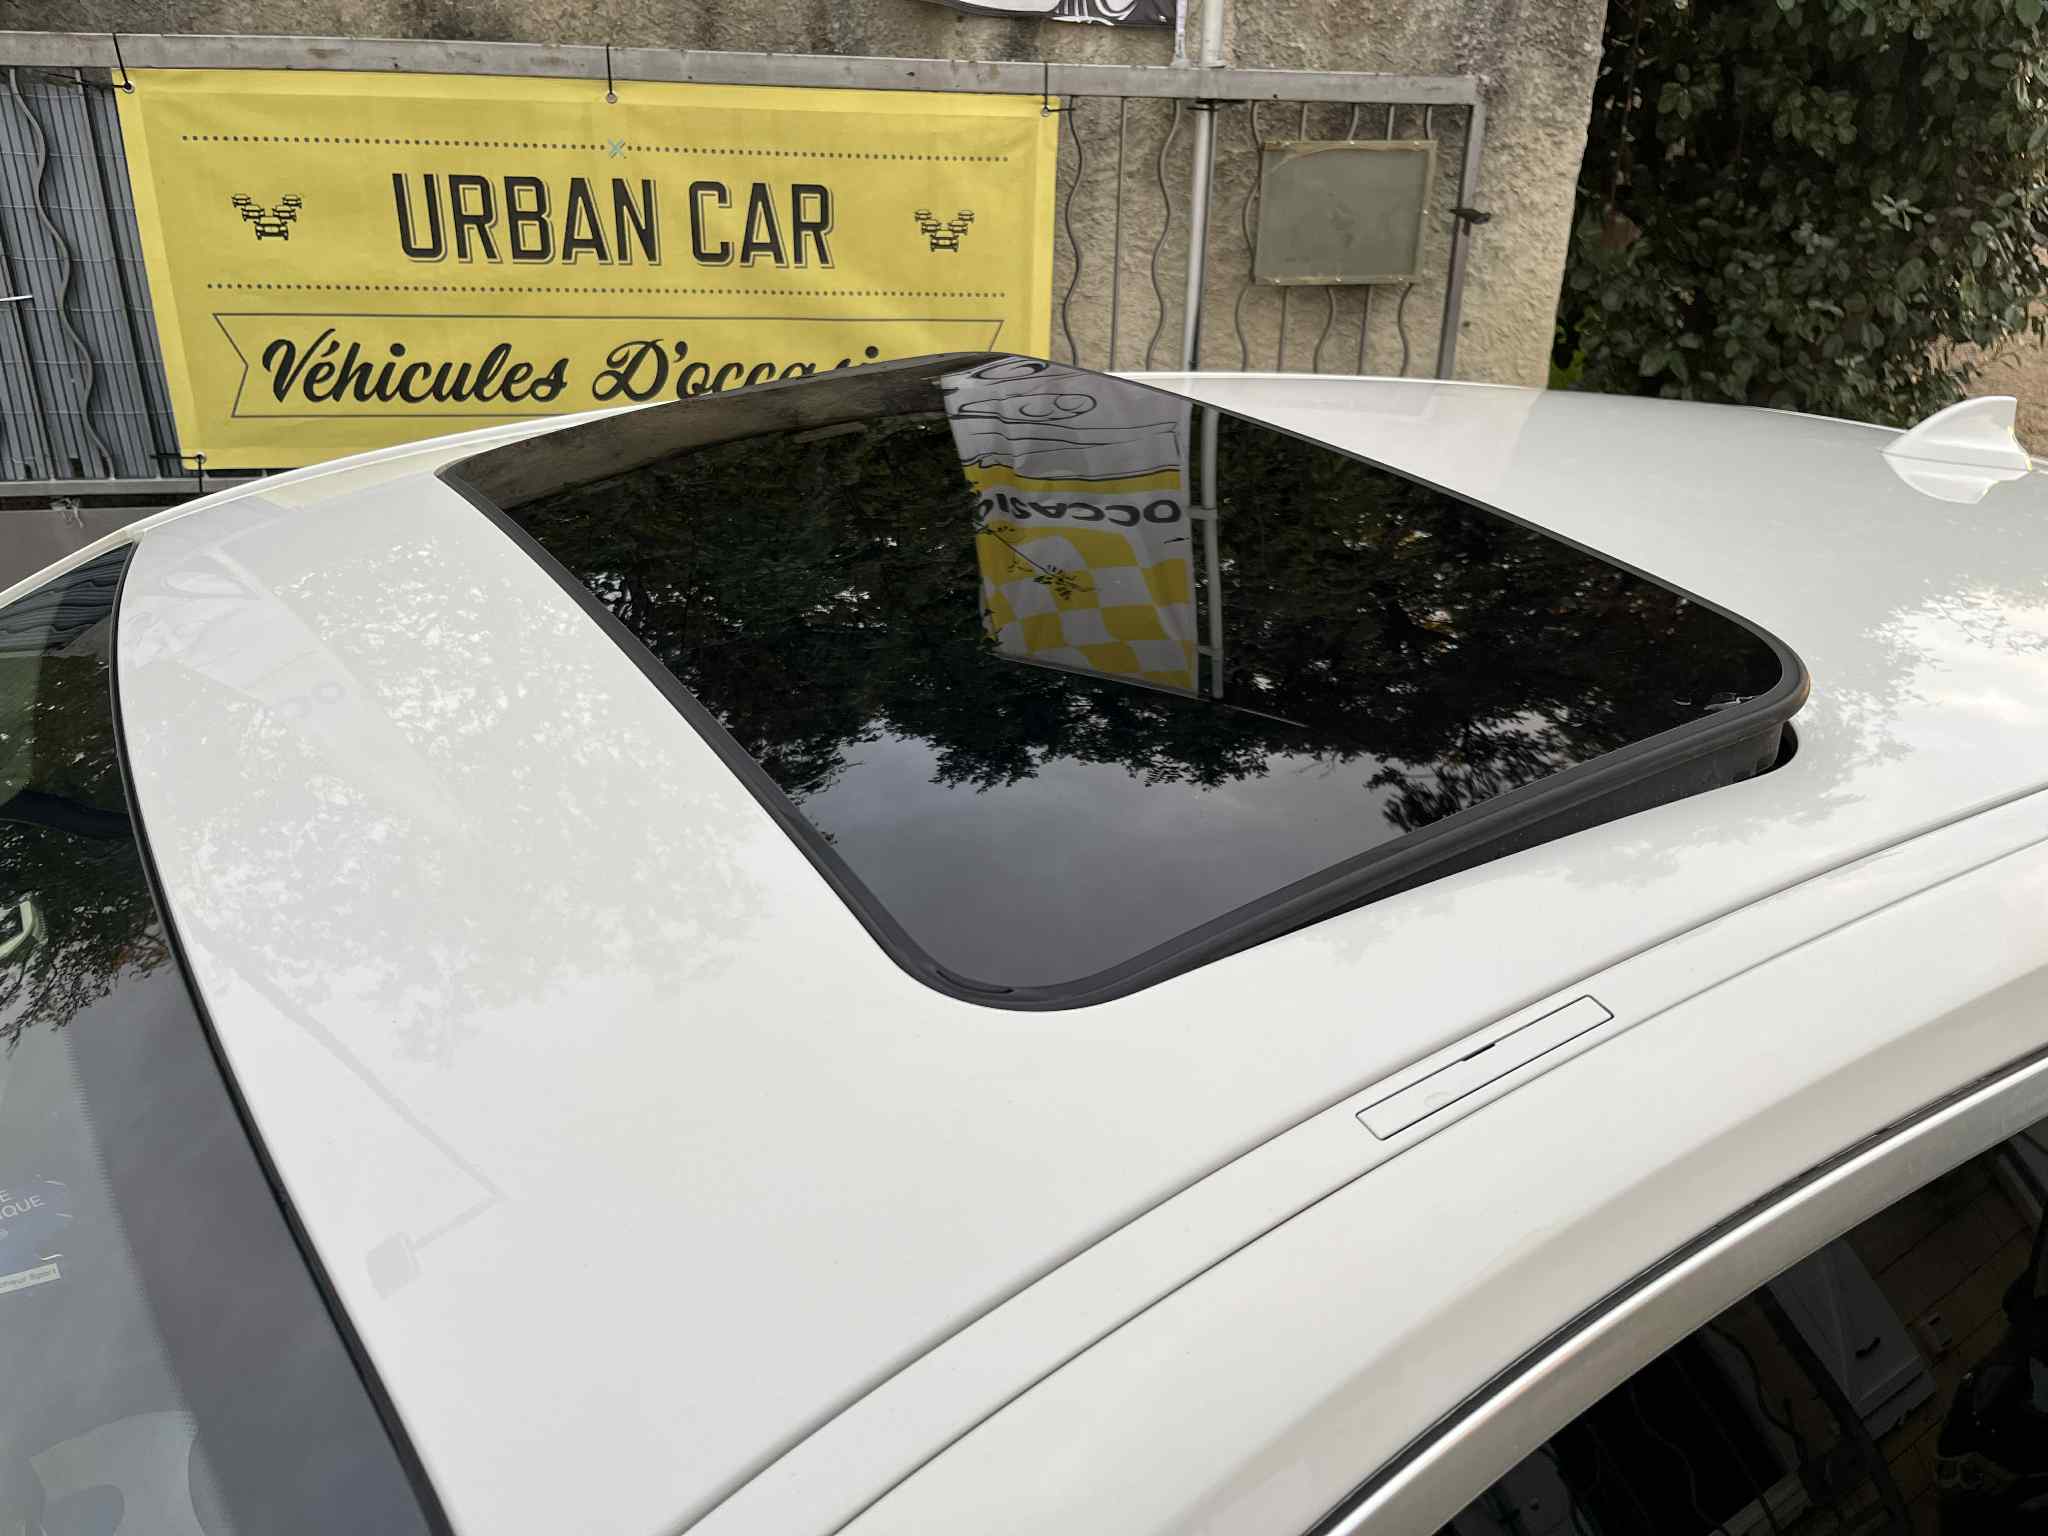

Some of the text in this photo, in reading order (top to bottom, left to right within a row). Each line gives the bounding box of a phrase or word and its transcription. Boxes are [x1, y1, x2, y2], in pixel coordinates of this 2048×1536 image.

[392, 173, 834, 269] URBAN CAR
[262, 328, 569, 402] Véhicules
[0, 1195, 46, 1217] QUE
